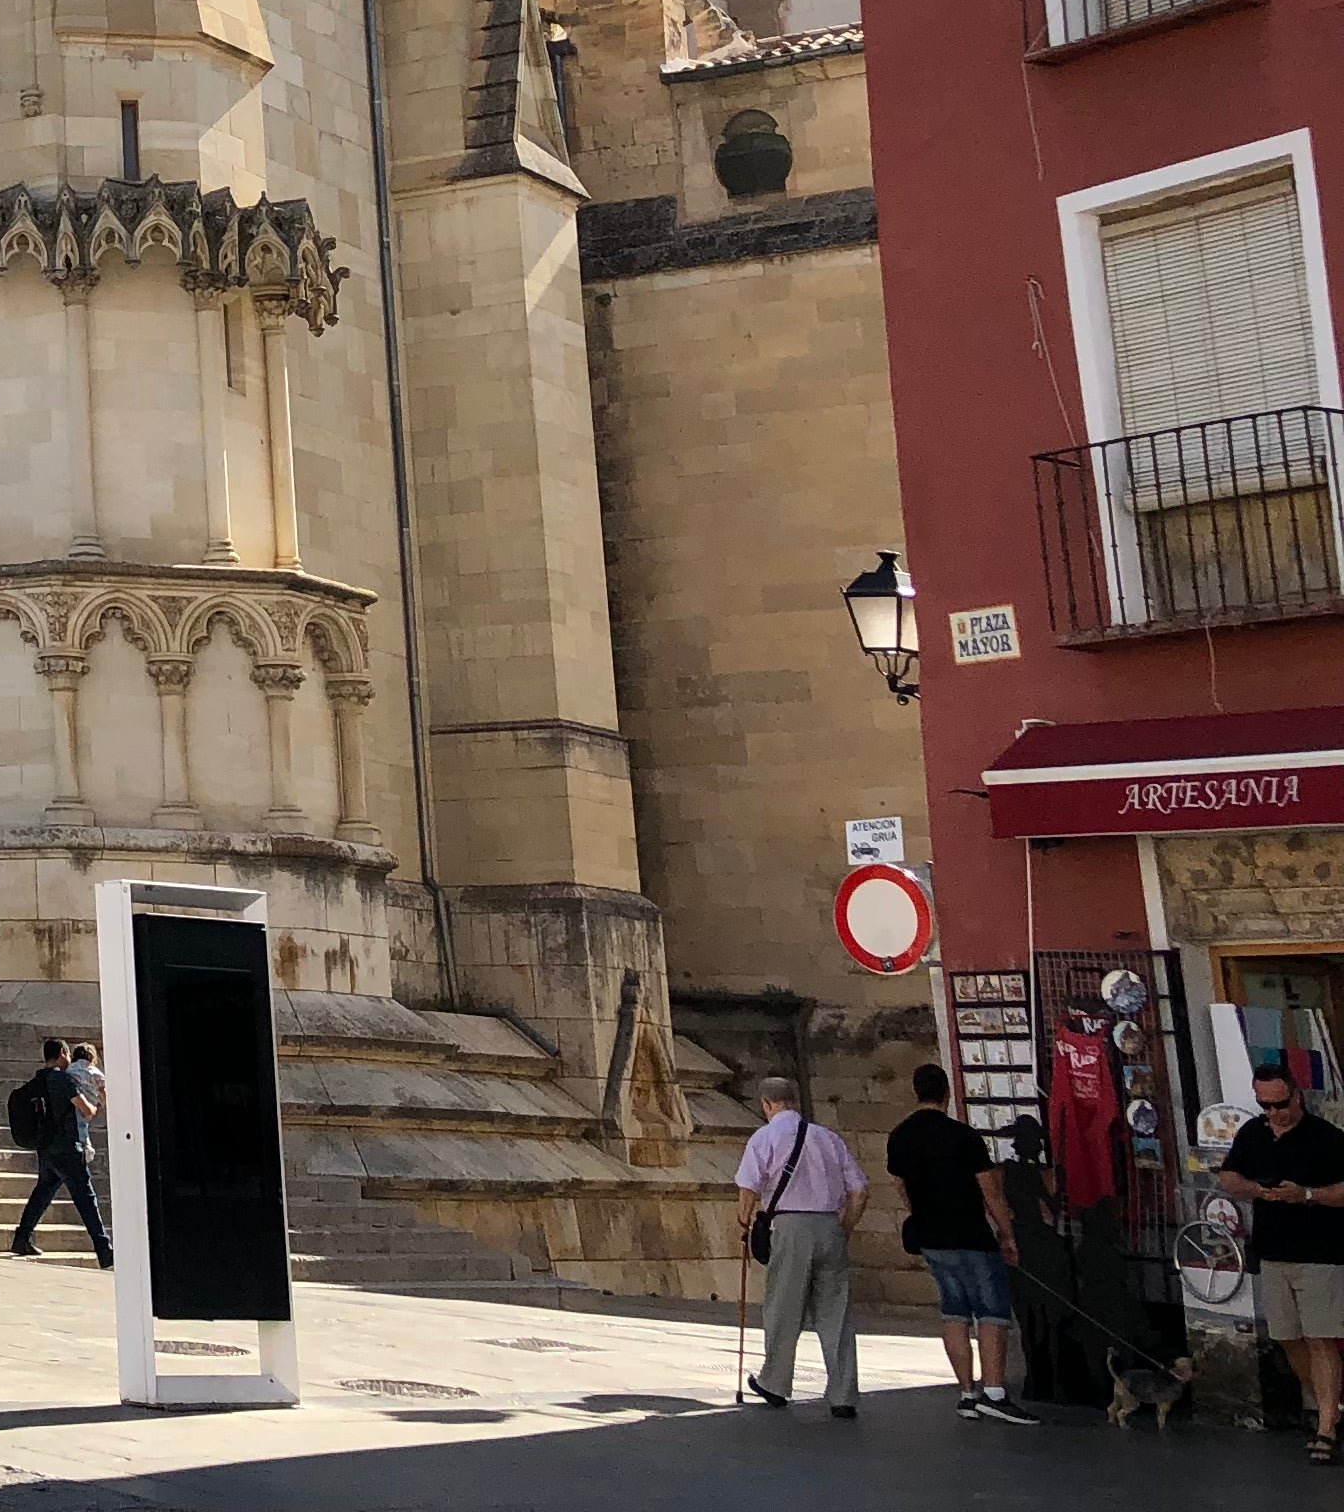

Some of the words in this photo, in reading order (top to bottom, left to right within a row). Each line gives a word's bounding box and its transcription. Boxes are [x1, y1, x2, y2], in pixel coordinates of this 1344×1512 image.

[970, 613, 1011, 636] PLAZA
[958, 634, 1012, 657] MAYOR
[1117, 775, 1301, 815] ARTESANIA
[852, 820, 896, 832] ATENCION
[872, 831, 898, 842] GRUA
